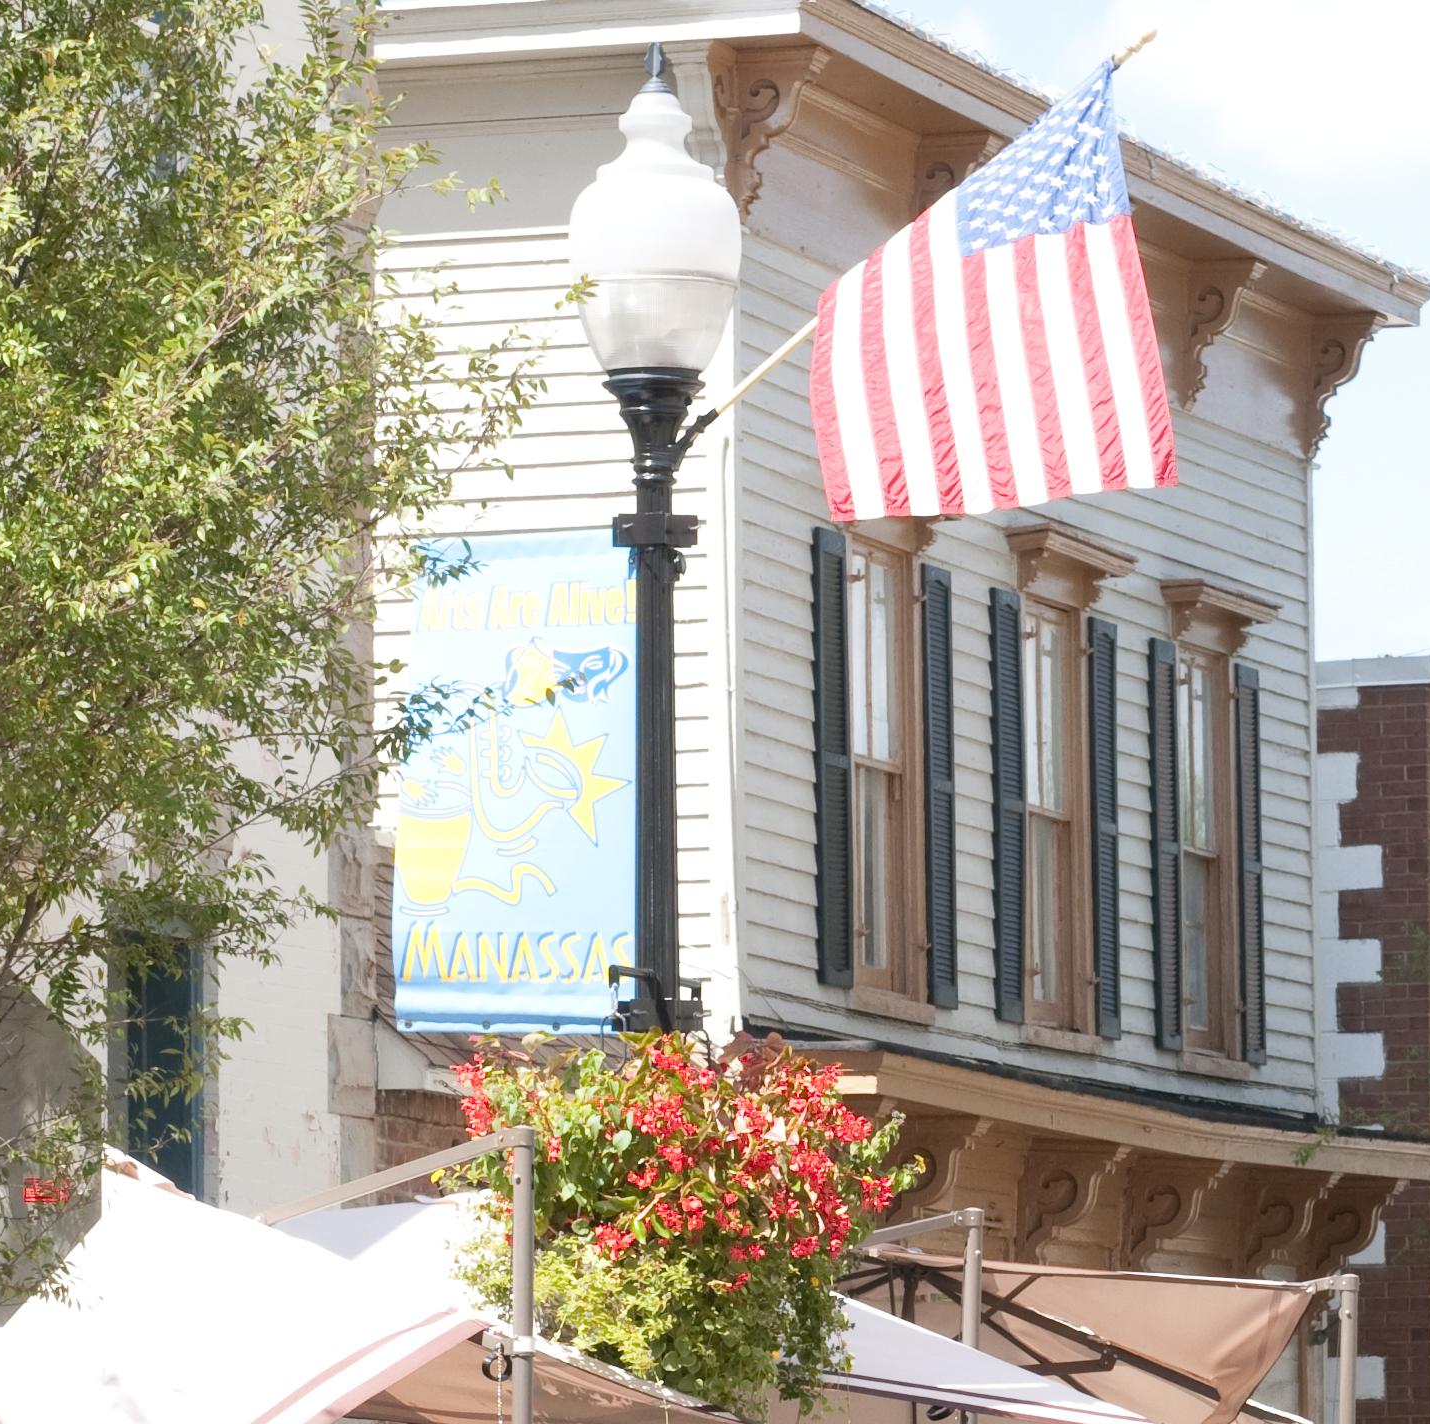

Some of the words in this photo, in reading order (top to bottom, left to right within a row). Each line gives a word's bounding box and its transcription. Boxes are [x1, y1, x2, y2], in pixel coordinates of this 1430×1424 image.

[417, 588, 482, 631] Arts
[485, 584, 542, 629] Are
[544, 578, 637, 627] Alive!
[400, 920, 635, 984] MANASSAS
